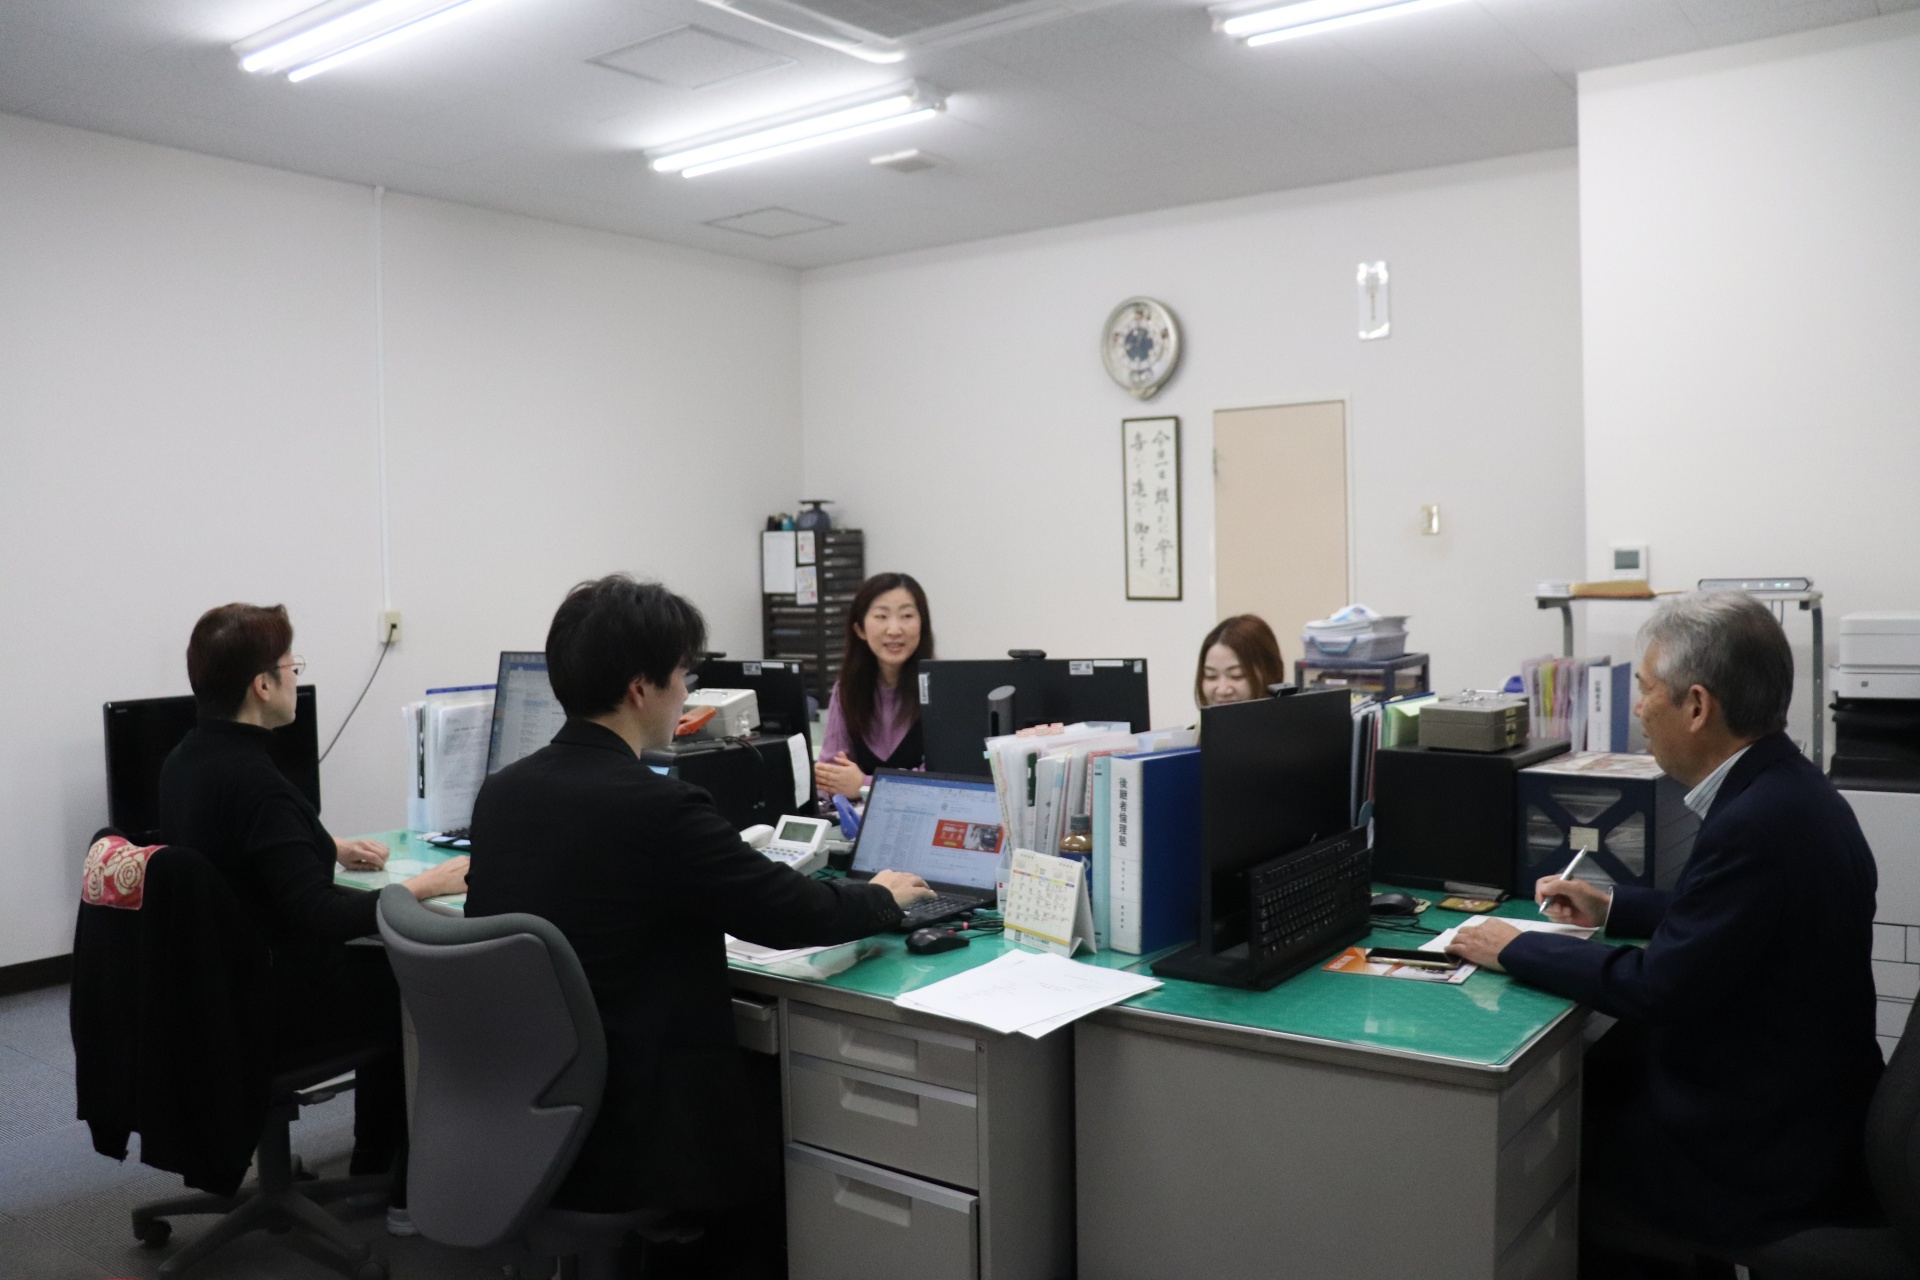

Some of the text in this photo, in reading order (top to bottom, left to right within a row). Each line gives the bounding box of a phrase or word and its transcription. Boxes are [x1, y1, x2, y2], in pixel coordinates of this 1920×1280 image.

[1118, 776, 1128, 848] 後継者倫理塾
